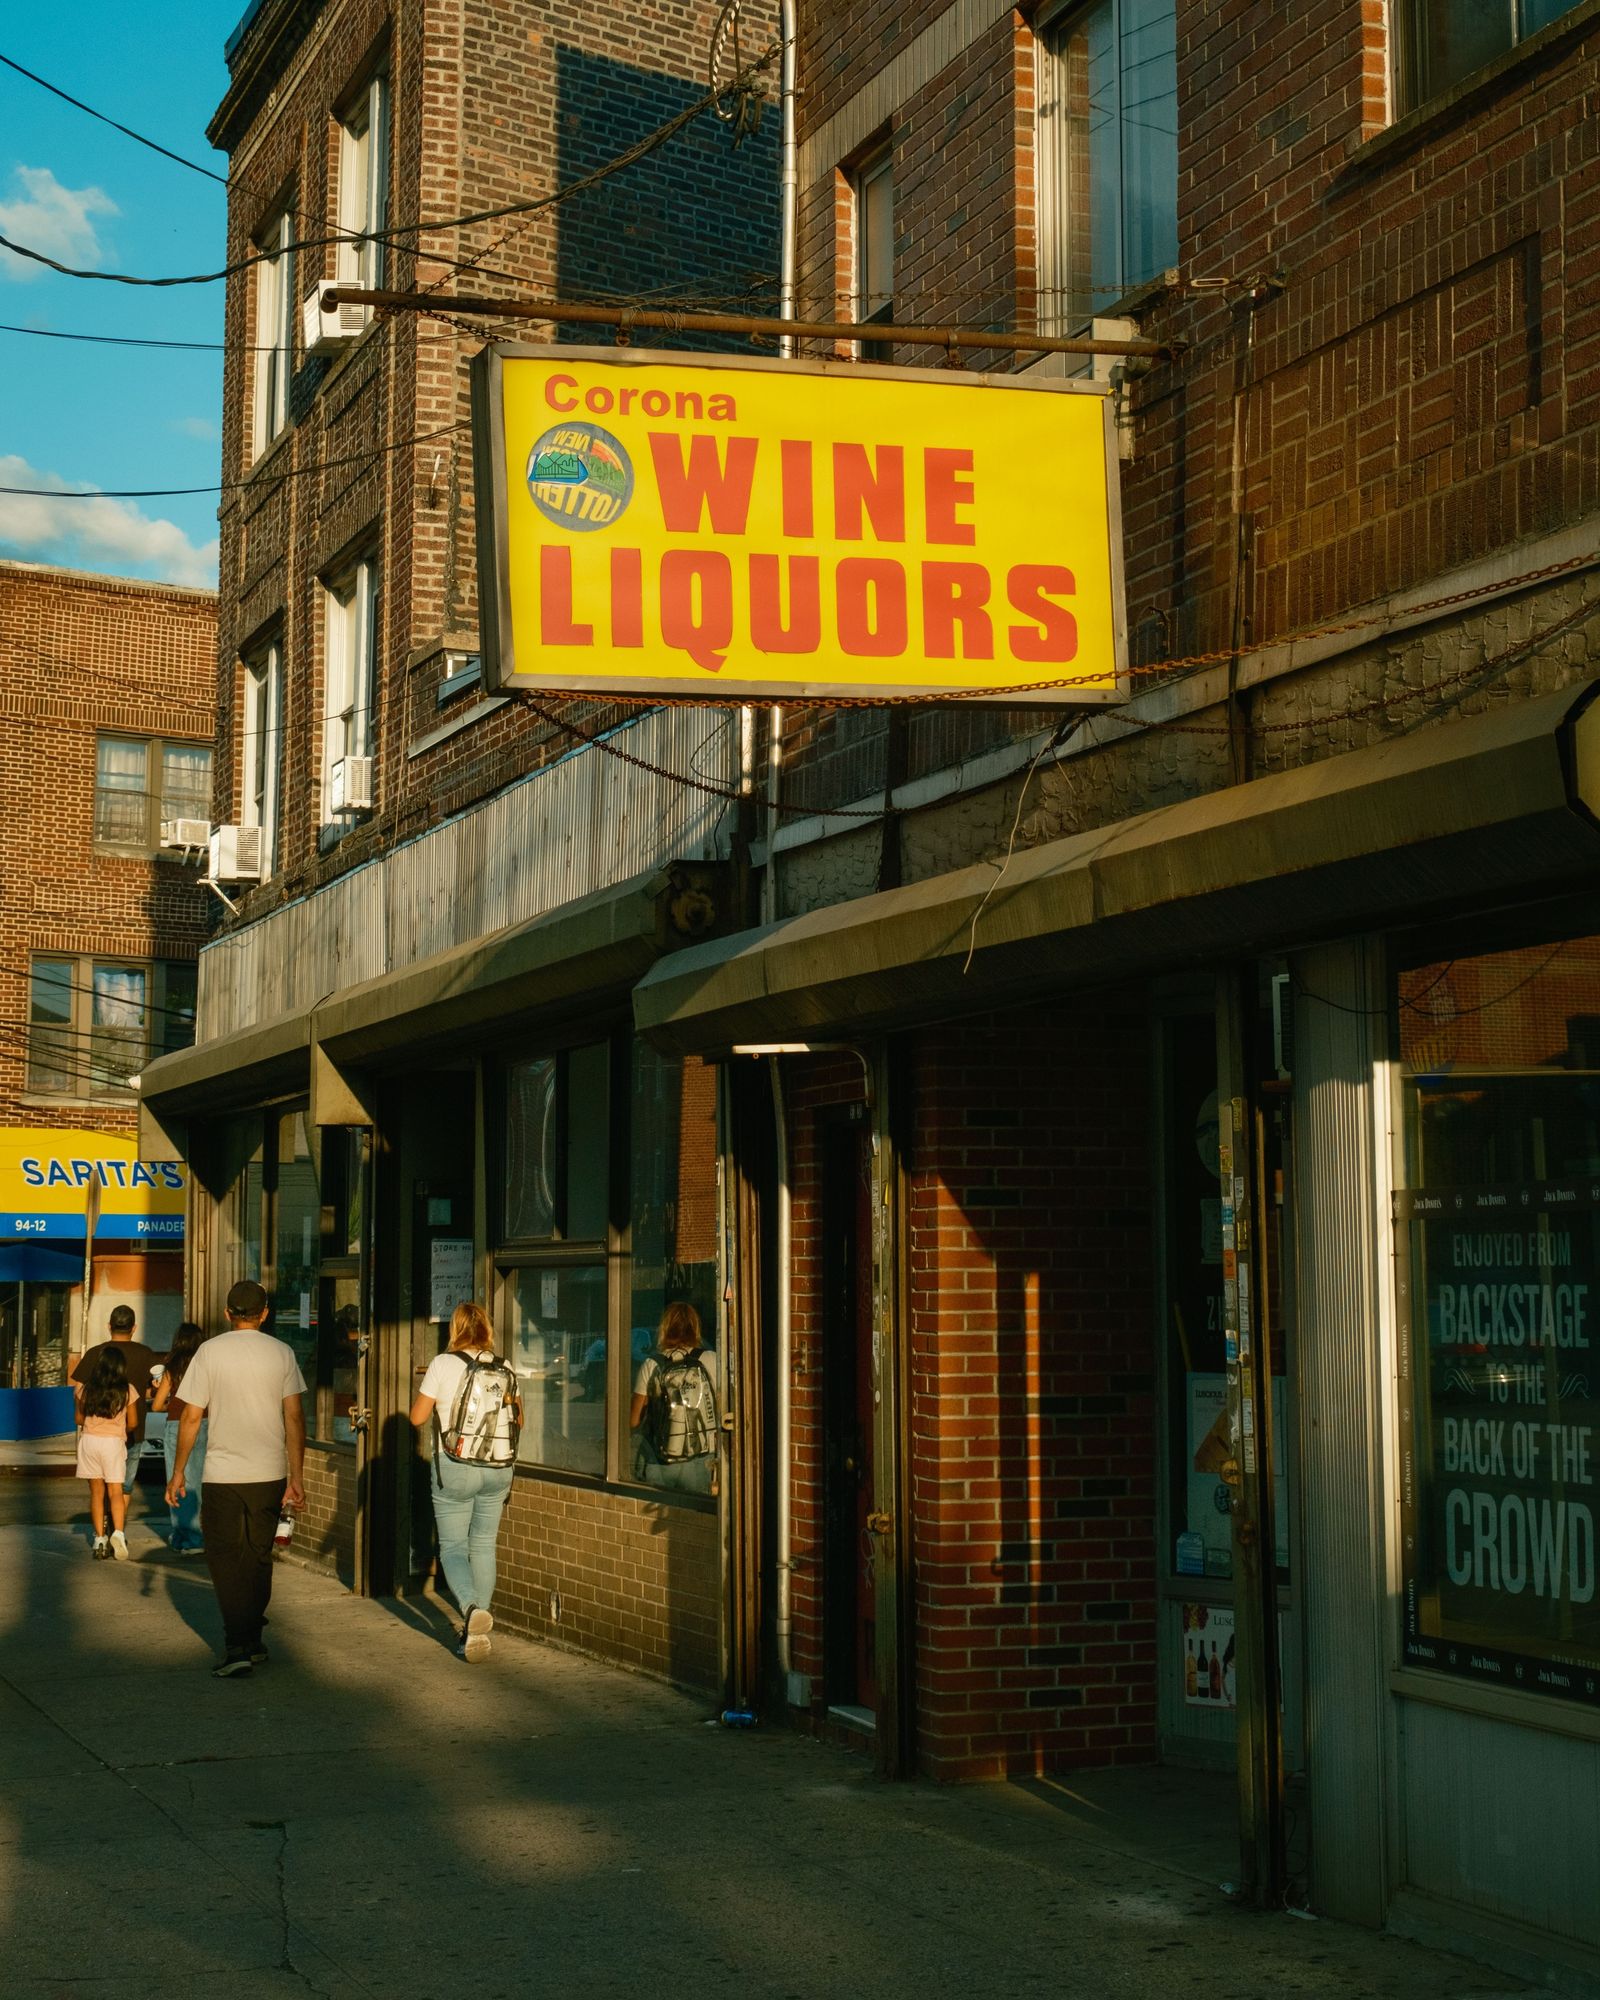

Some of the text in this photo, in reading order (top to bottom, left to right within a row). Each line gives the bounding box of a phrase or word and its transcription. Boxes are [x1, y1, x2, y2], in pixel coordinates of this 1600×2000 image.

[544, 374, 737, 422] Corona
[647, 431, 977, 546] WINE
[539, 543, 1079, 673] LIQUORS
[22, 1159, 184, 1188] SARITA'S
[15, 1219, 47, 1232] 94-12
[1453, 1231, 1572, 1267] ENJOYED FROM
[1439, 1284, 1590, 1349] BACKSTAGE
[1486, 1362, 1547, 1406] TO THE
[1443, 1416, 1593, 1485] BACK OF THE
[1445, 1488, 1595, 1604] CROWD
